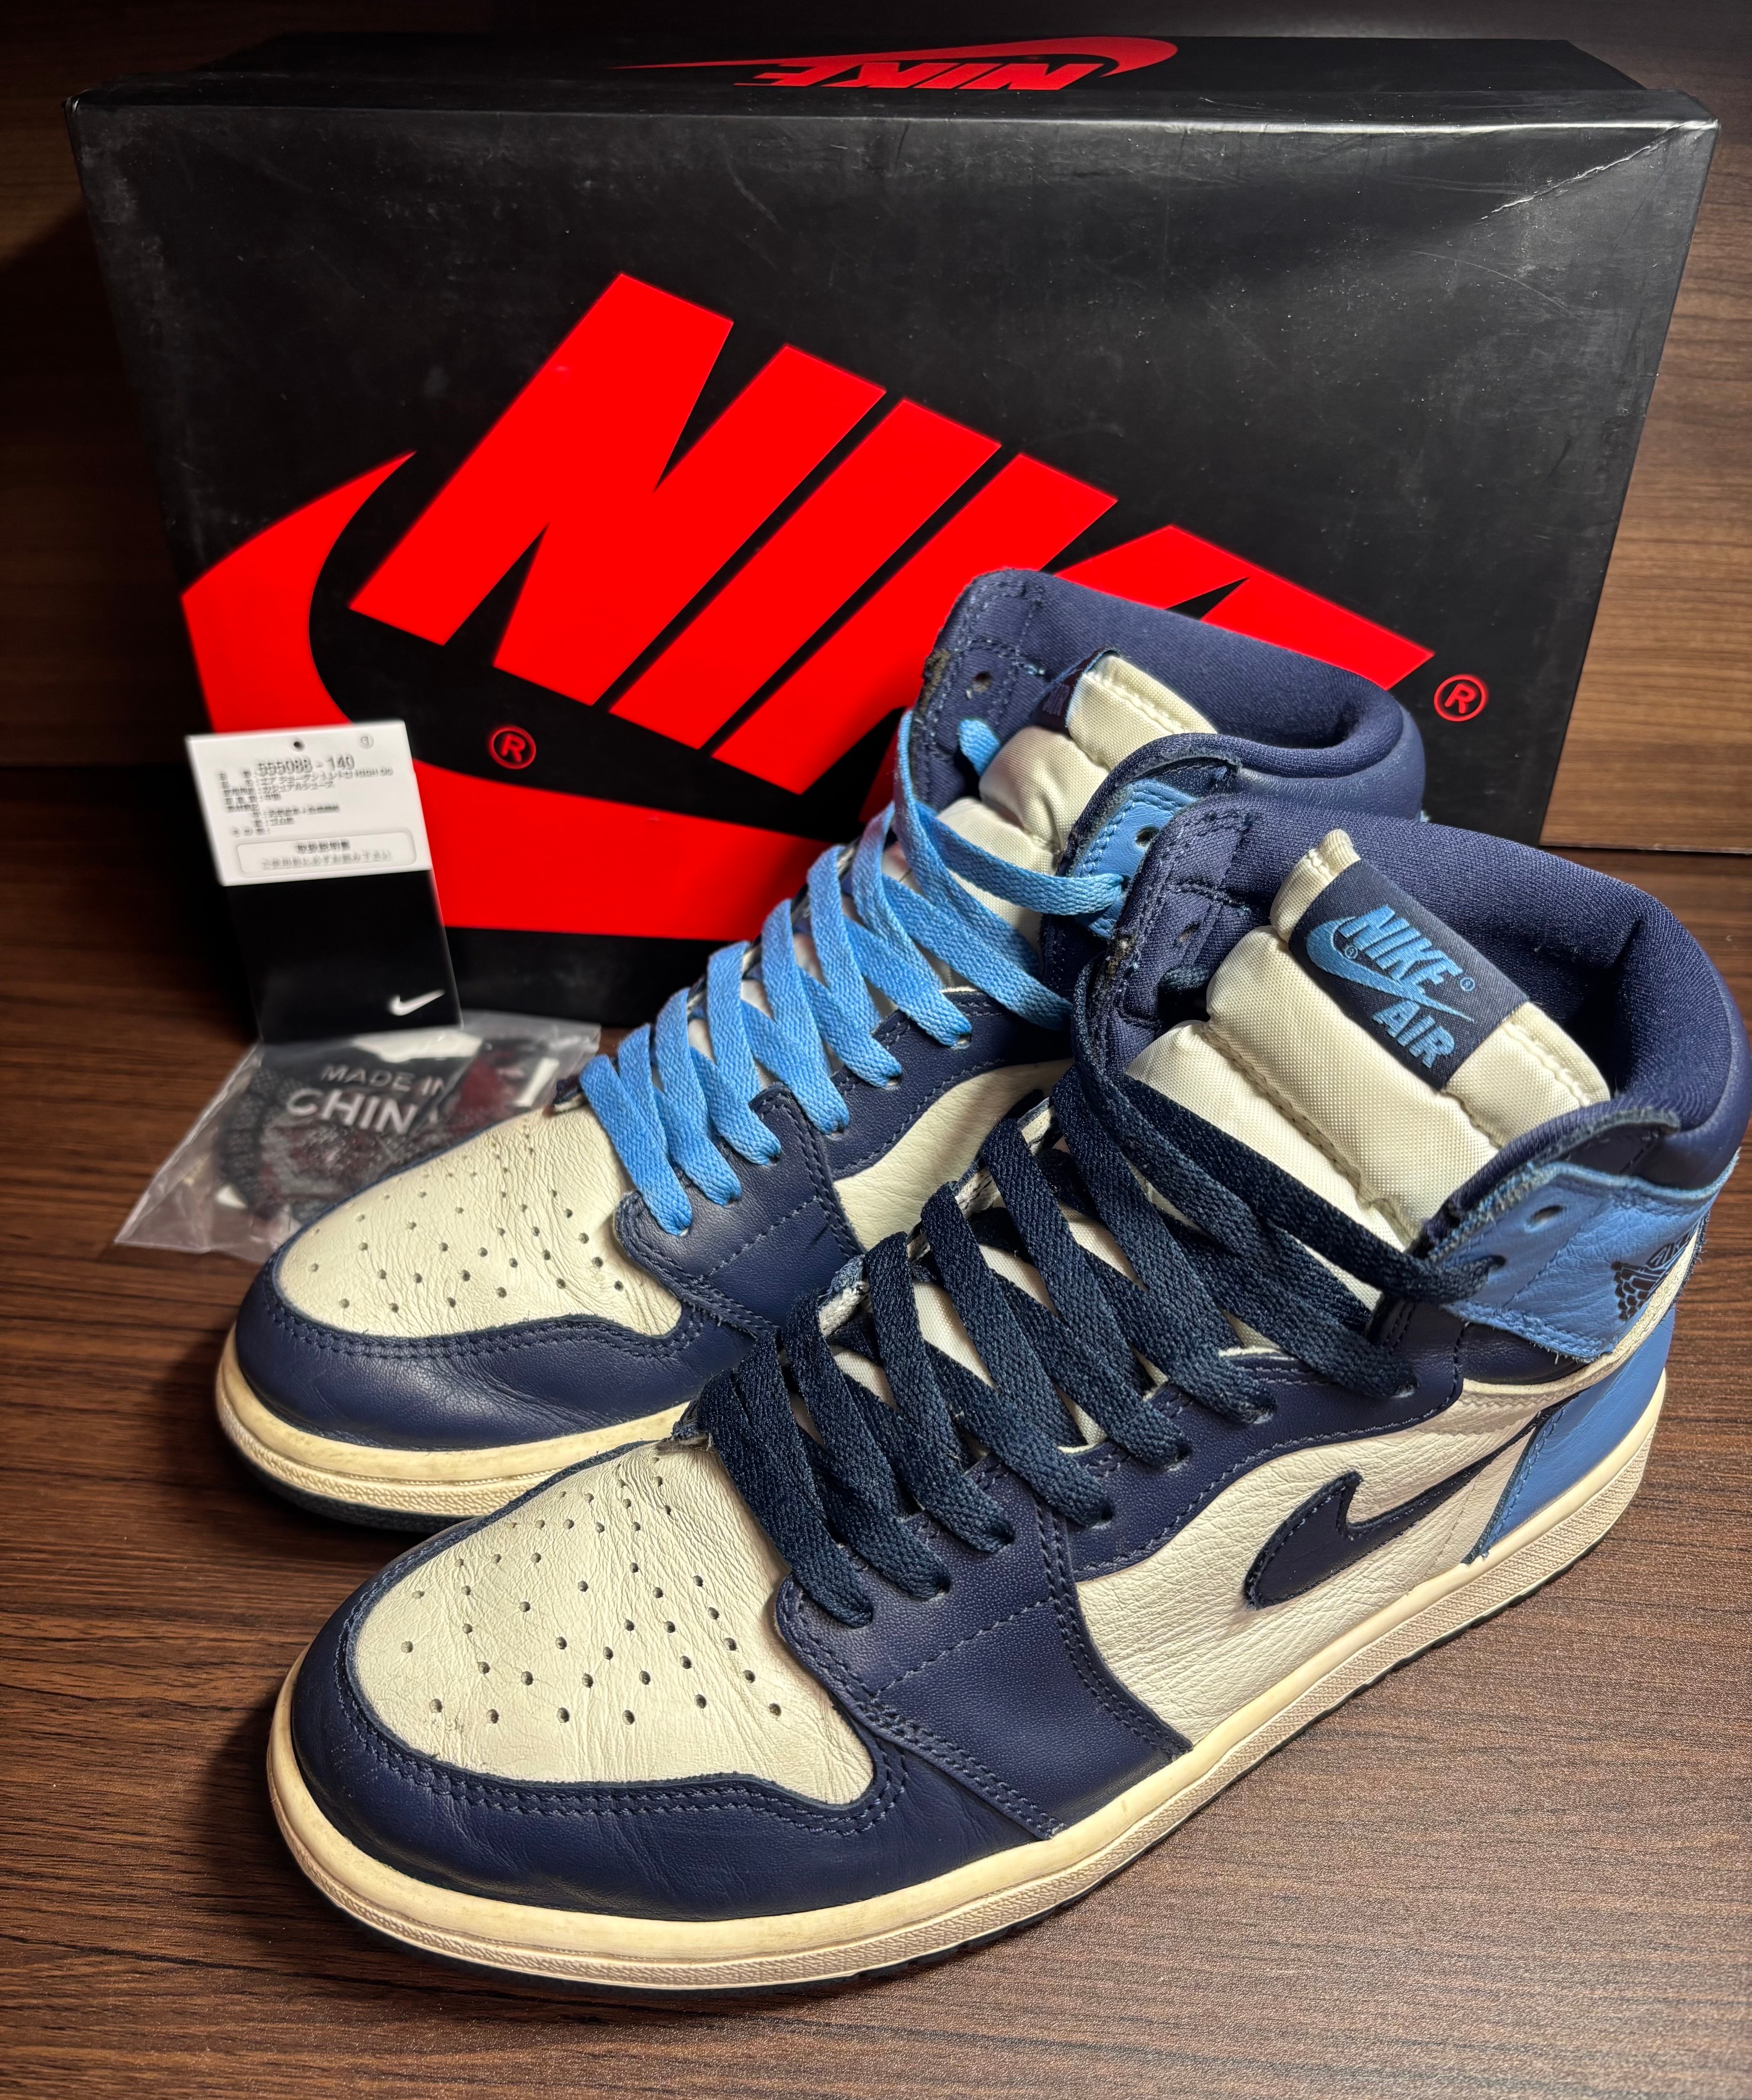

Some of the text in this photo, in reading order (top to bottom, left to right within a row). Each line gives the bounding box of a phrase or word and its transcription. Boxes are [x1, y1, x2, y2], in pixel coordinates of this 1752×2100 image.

[733, 62, 1103, 90] NIKE
[350, 273, 1434, 802] NIK
[1340, 905, 1463, 993] NIKE
[1372, 1000, 1455, 1068] AIR
[321, 1064, 415, 1093] MADE
